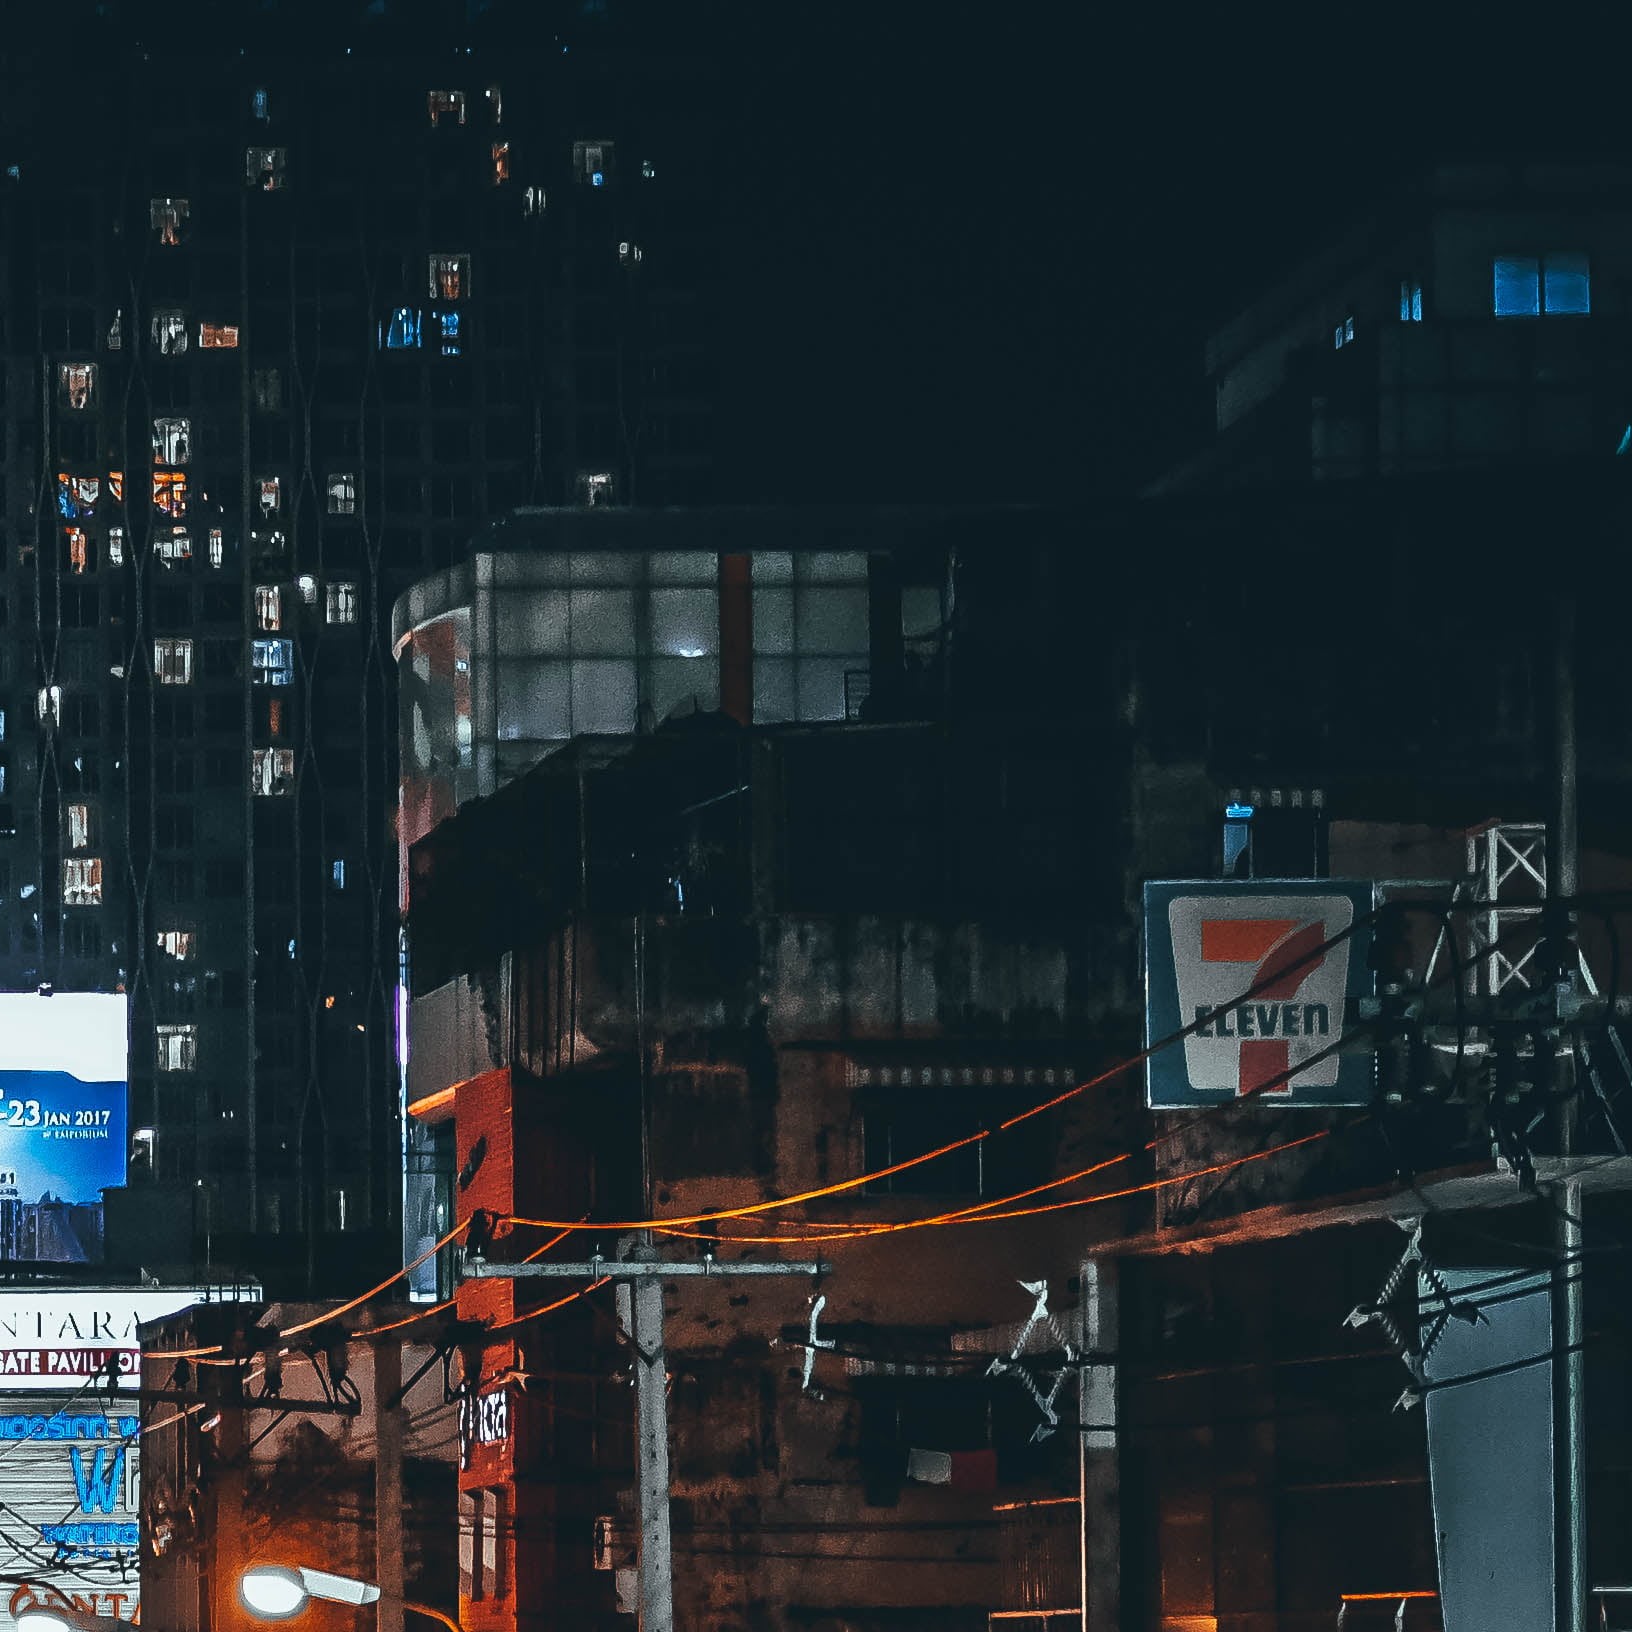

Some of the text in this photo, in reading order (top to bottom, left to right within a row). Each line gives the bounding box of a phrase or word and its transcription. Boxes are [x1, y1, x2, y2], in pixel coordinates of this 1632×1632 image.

[44, 1110, 71, 1127] JAN
[75, 1110, 110, 1125] 2017
[47, 1351, 141, 1374] PAVILLON
